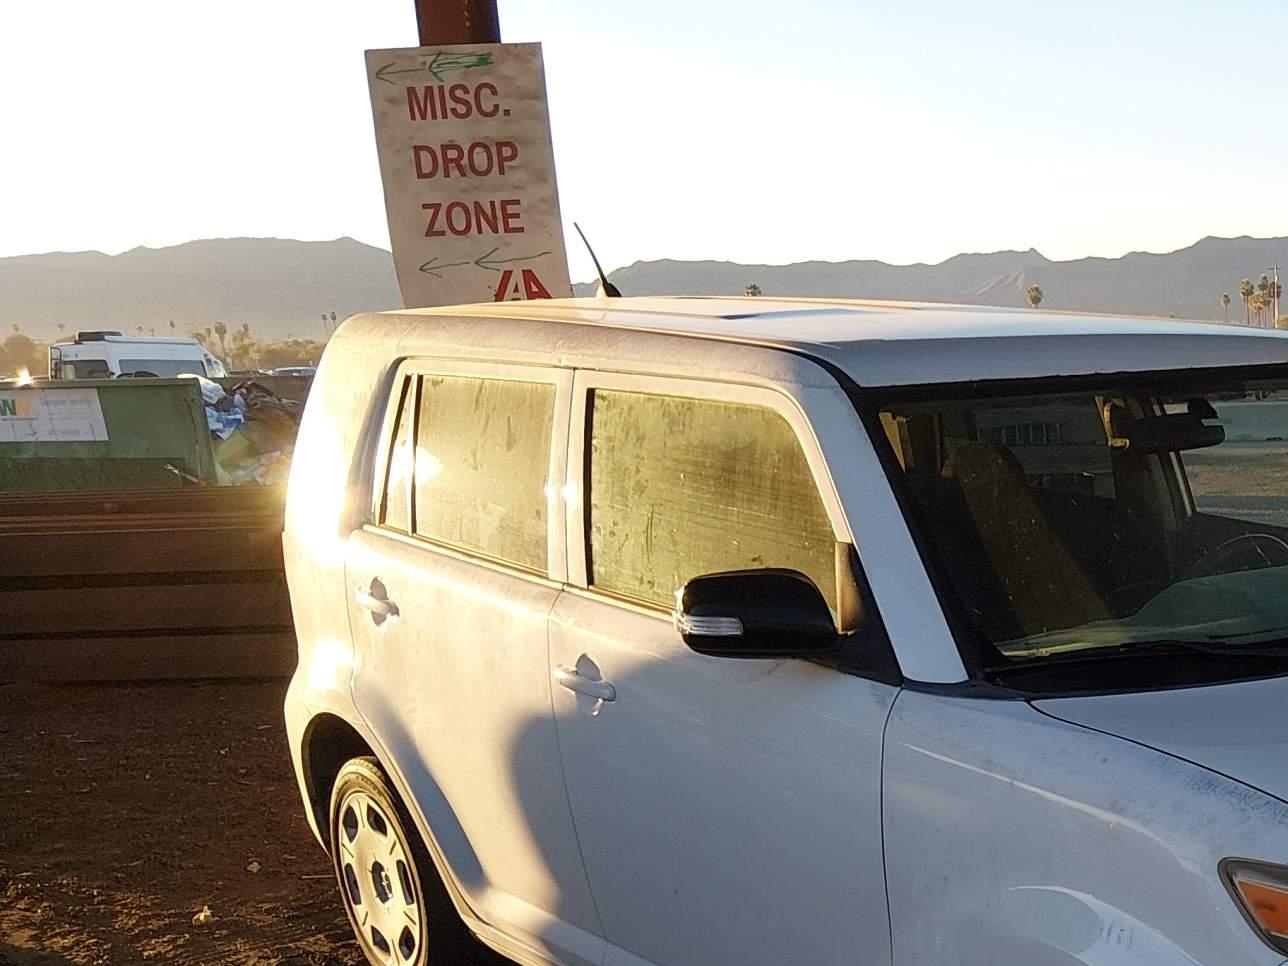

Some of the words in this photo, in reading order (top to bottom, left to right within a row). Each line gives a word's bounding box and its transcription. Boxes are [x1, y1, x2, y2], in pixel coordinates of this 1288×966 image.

[406, 82, 511, 121] MISC.
[413, 141, 518, 180] DROP
[422, 199, 525, 238] ZONE
